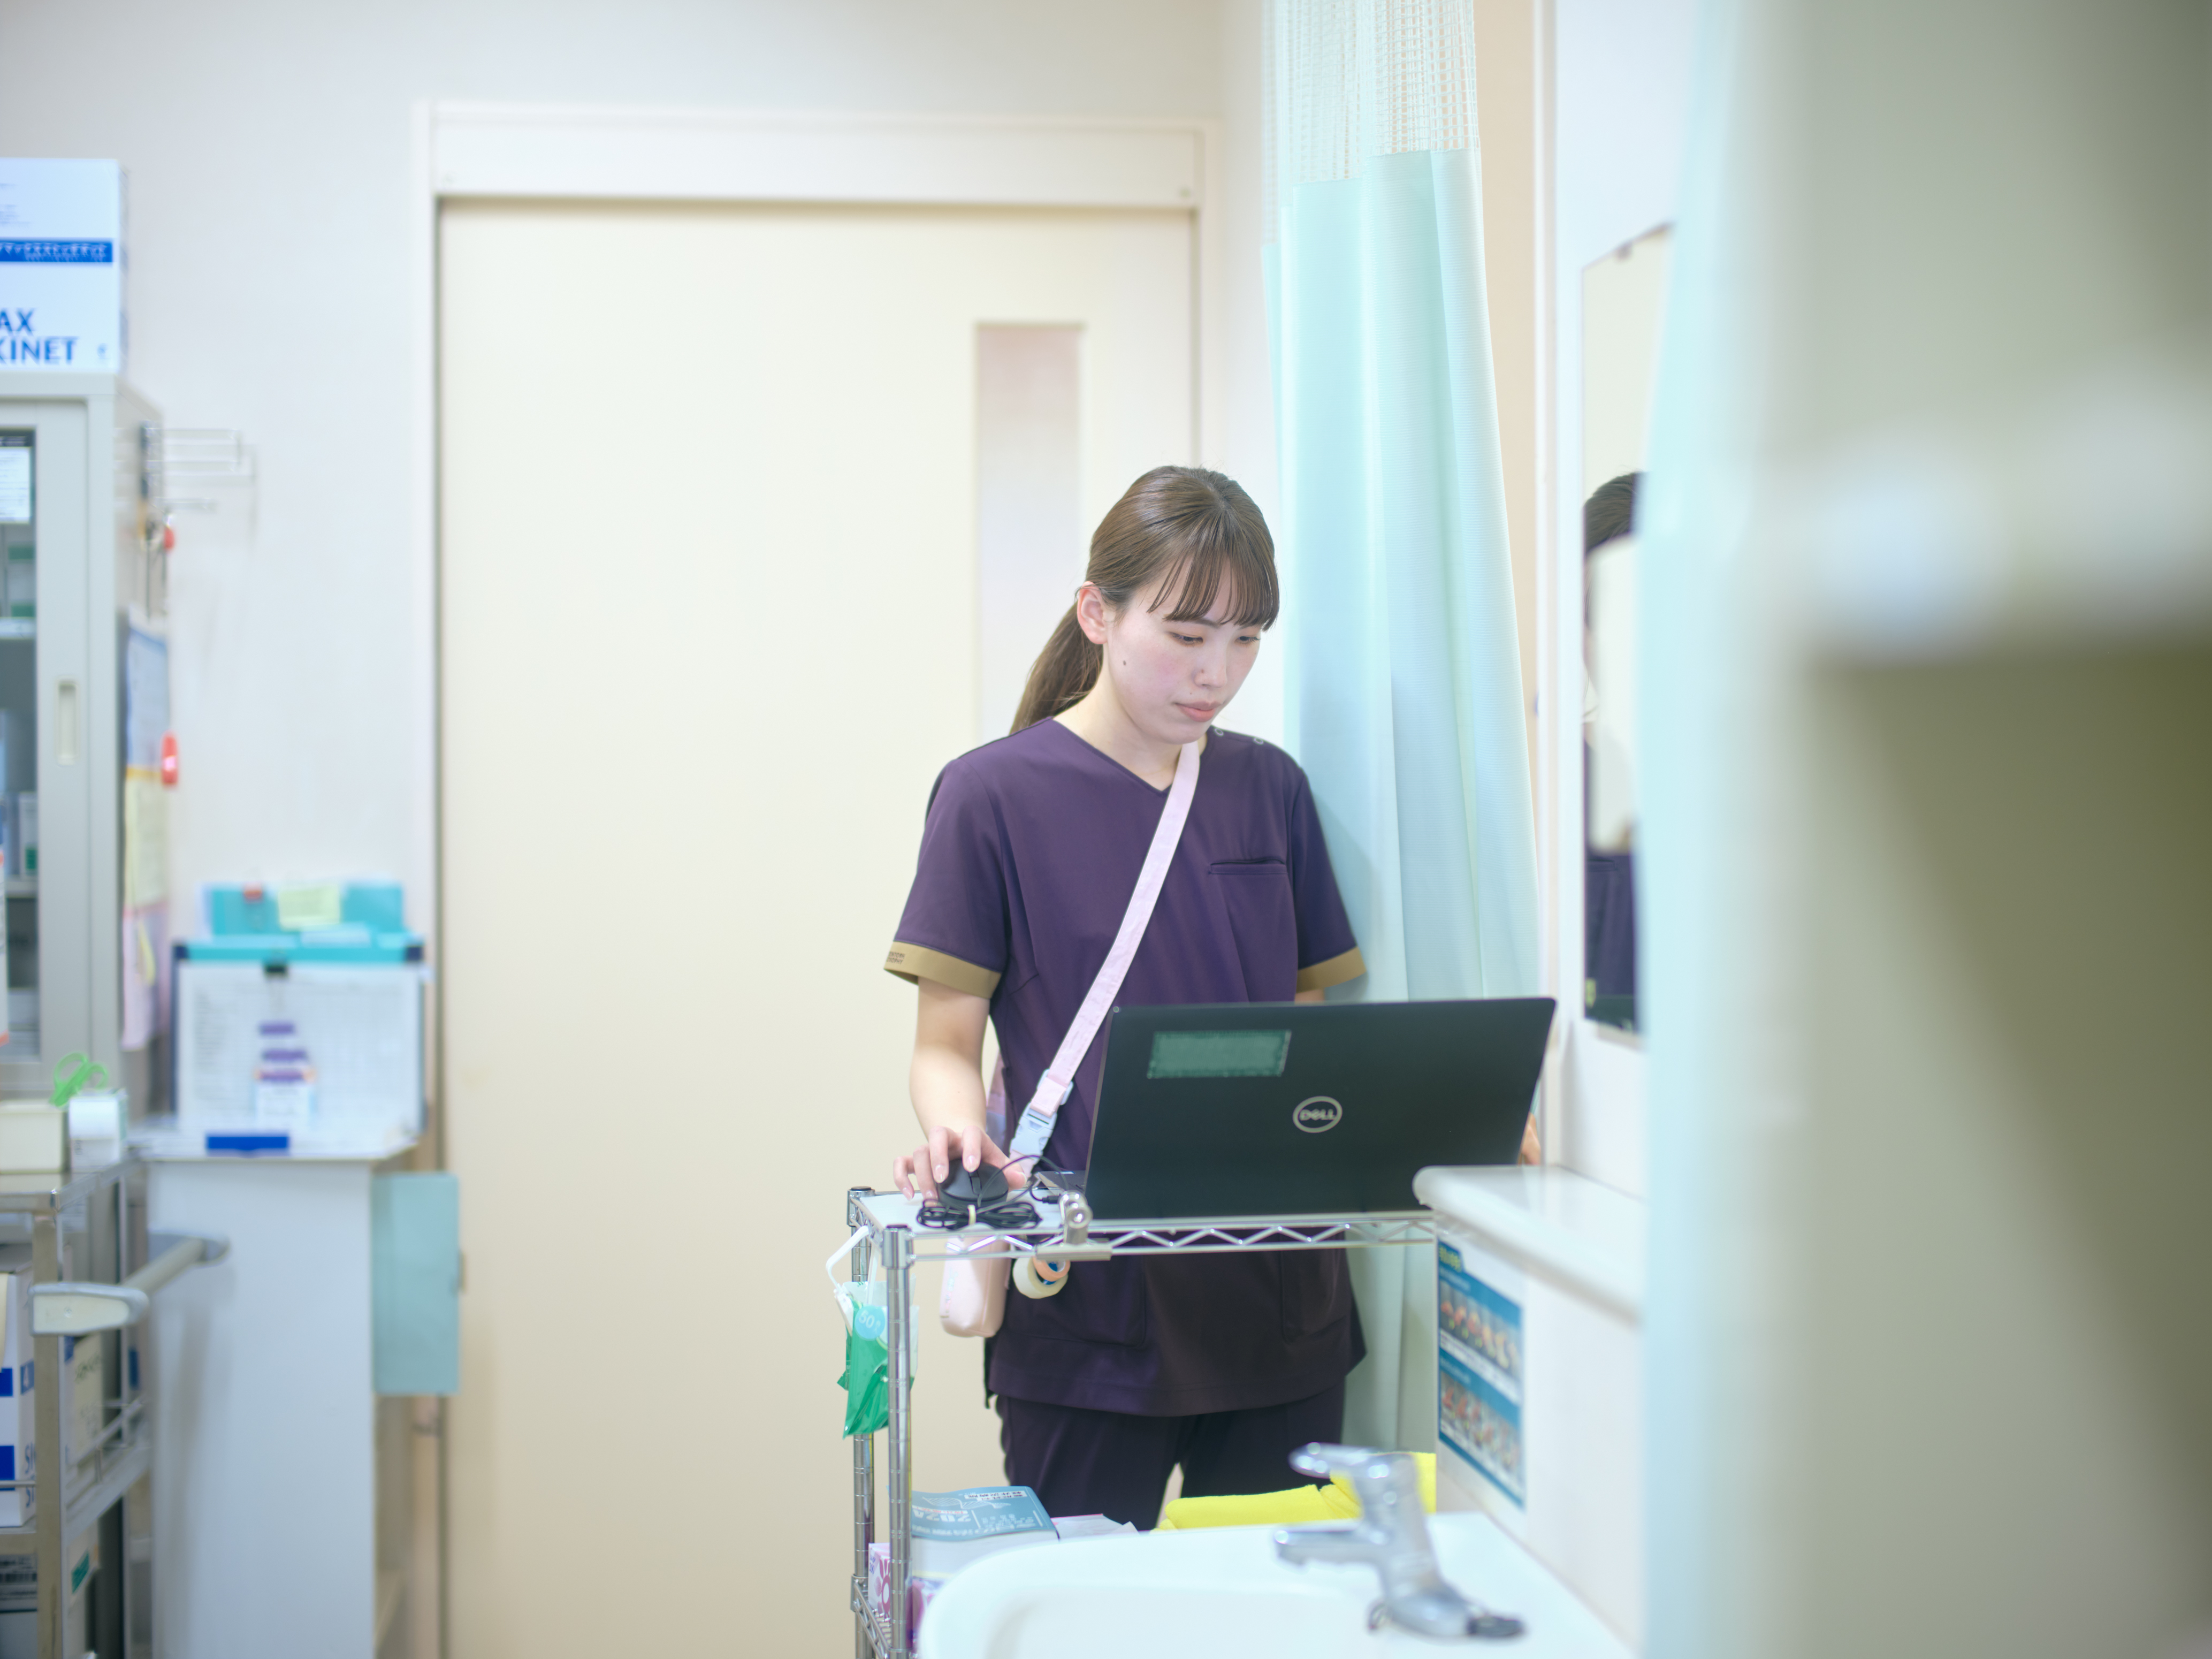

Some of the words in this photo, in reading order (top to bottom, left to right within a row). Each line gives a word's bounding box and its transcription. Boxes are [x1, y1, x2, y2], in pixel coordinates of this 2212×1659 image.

[1300, 1108, 1337, 1121] DELL
[859, 1310, 874, 1328] 50
[913, 1510, 971, 1521] 2024
